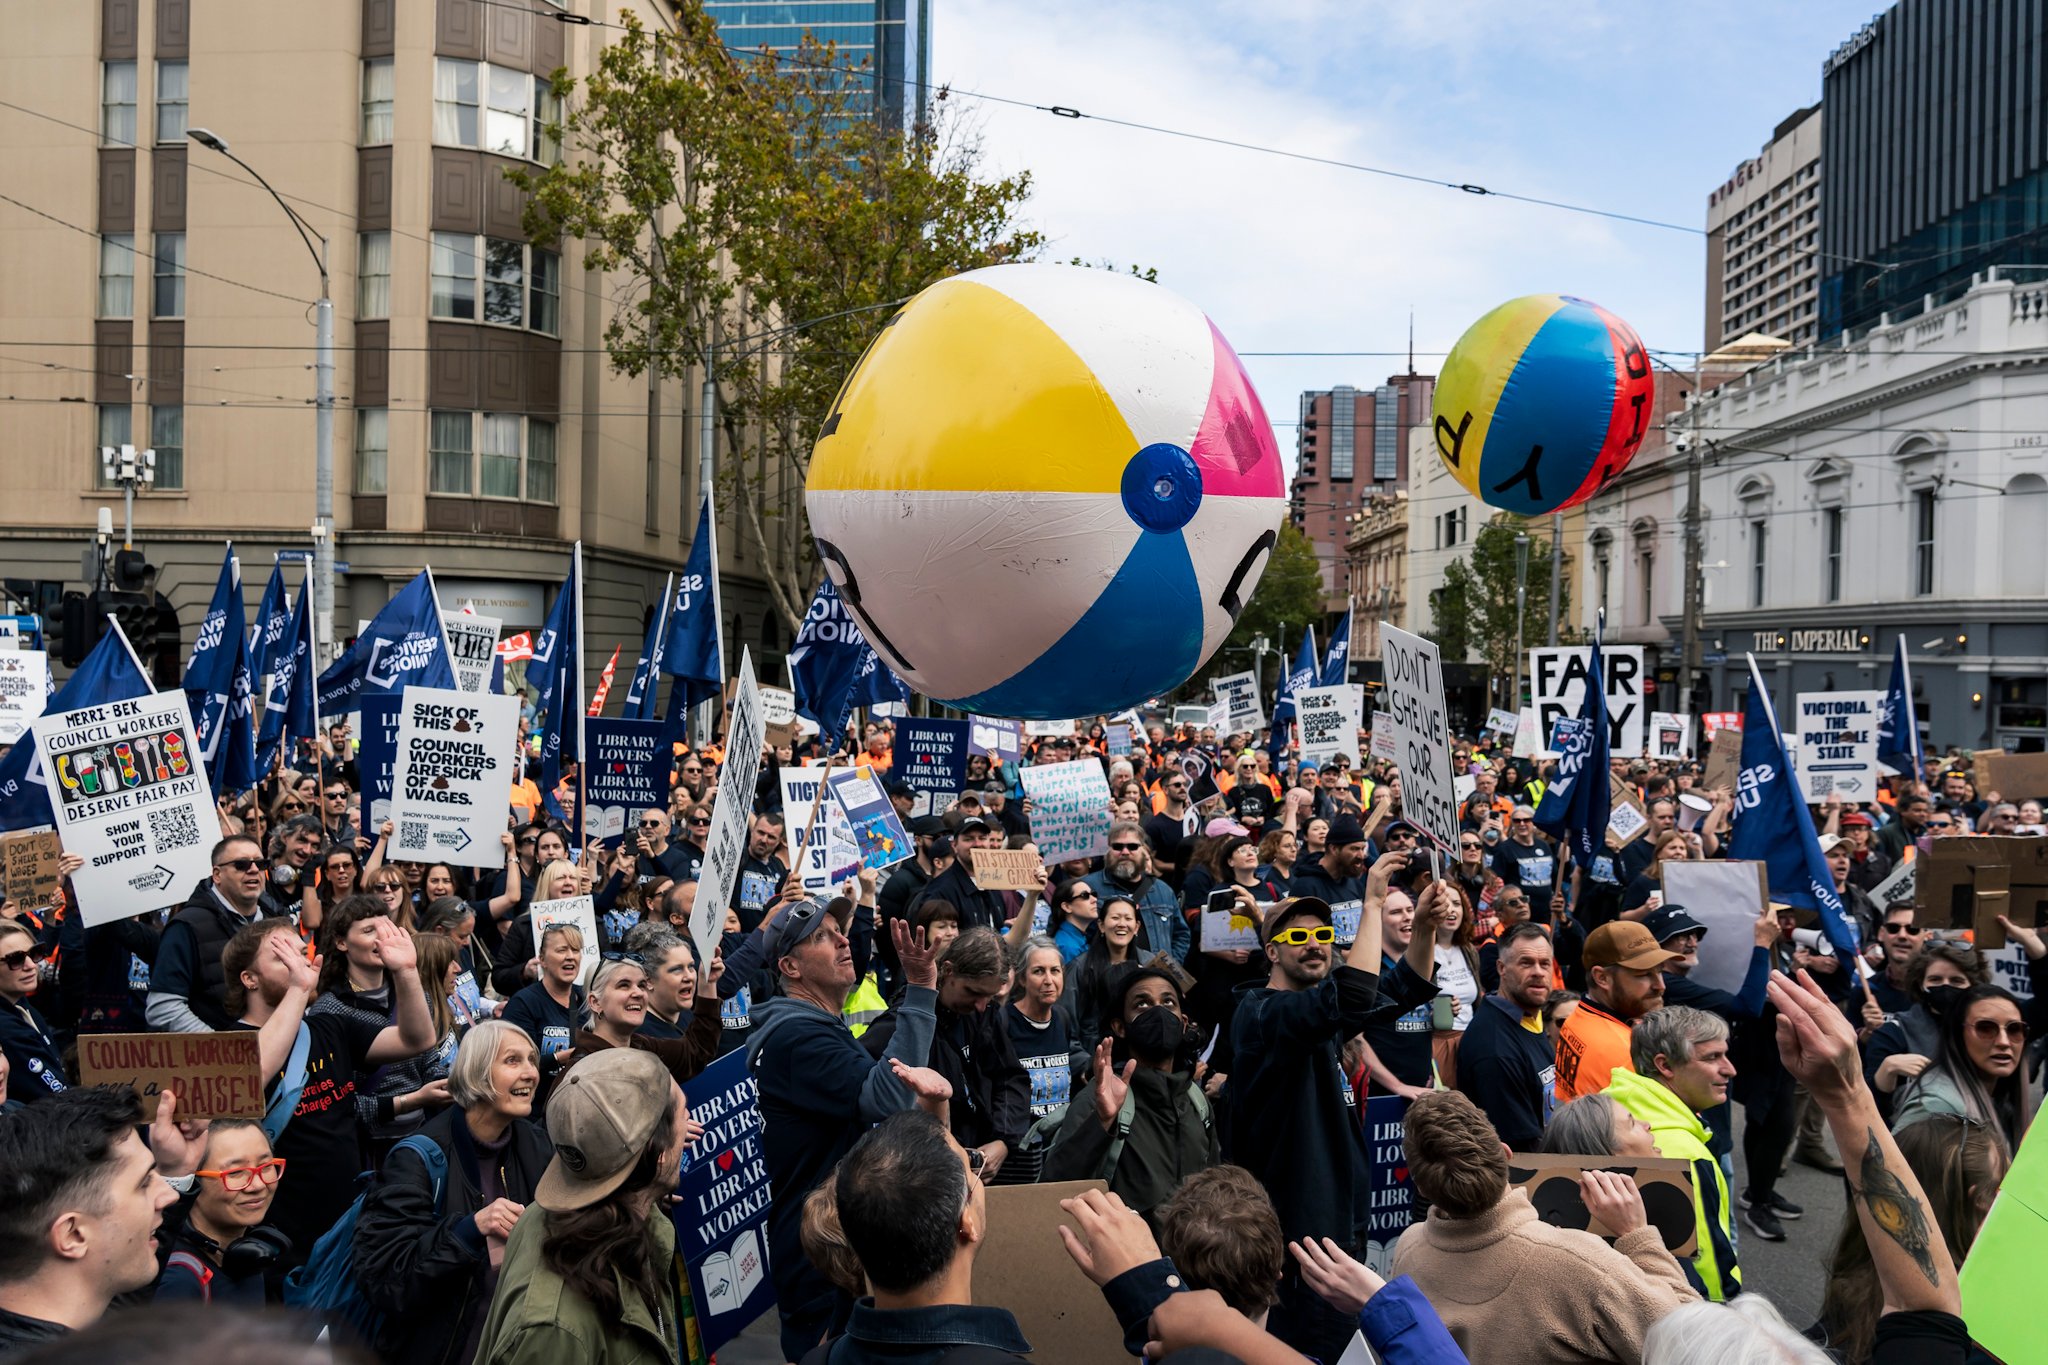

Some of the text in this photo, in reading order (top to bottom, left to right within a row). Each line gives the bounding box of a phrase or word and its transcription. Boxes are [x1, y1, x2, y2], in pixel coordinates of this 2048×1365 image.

[1710, 156, 1763, 208] RYDGES
[465, 625, 495, 635] WORKERS
[1754, 629, 1861, 652] THE IMPERIAL
[476, 661, 489, 670] PAY
[1388, 639, 1431, 694] DON'T
[1216, 676, 1253, 692] VICTORIA.
[1230, 686, 1243, 695] THE
[1230, 701, 1250, 712] STATE
[1301, 694, 1333, 704] SICK OF
[1301, 701, 1321, 710] THIS
[66, 701, 142, 728] MERRI-BEK
[413, 703, 479, 721] SICK OF
[1302, 710, 1340, 721] COUNCIL
[1803, 701, 1871, 715] VICTORIA.
[412, 716, 485, 734] THIS ?
[975, 715, 1014, 729] WORKERS
[1303, 716, 1347, 726] WORKERS
[1392, 689, 1443, 747] SHELVE
[1825, 716, 1848, 730] THE
[50, 712, 181, 750] COUNCIL WORKERS
[1321, 723, 1341, 731] SICK
[1540, 702, 1637, 750] PY
[597, 734, 658, 748] LIBRARY
[908, 730, 956, 742] LIBRARY
[1304, 730, 1316, 739] OF
[1305, 736, 1339, 745] WAGES.
[410, 737, 486, 756] COUNCIL
[910, 742, 953, 753] LOVERS
[1817, 746, 1855, 760] STATE
[408, 750, 497, 770] WORKERS
[599, 748, 653, 762] LOVERS
[906, 764, 953, 776] LIBRARY
[1408, 740, 1437, 786] OUR
[407, 763, 483, 781] ARE SICK
[406, 775, 429, 788] OF
[593, 775, 654, 789] LIBRARY
[902, 776, 956, 789] WORKERS
[1027, 777, 1064, 795] failure
[68, 779, 196, 821] DESERVE FAIR PAY
[405, 788, 473, 806] WAGES.
[588, 788, 657, 803] WORKERS
[1042, 804, 1059, 815] NO
[1061, 799, 1079, 814] PAY
[1082, 797, 1108, 808] offer
[1401, 769, 1457, 852] WAGES!
[402, 811, 470, 823] SHOW YOUR SUPPORT
[1031, 818, 1043, 828] on
[1046, 815, 1063, 826] the
[105, 820, 140, 837] SHOW
[112, 832, 144, 849] YOUR
[432, 832, 463, 841] SERVICES
[436, 838, 458, 846] UNION
[1038, 835, 1094, 856] crisis!
[92, 845, 147, 868] SUPPORT
[991, 852, 1040, 868] STRIKING
[128, 871, 165, 886] SERVICES
[134, 879, 161, 891] UNION
[1882, 874, 1910, 900] SICK
[539, 899, 585, 914] SUPPORT
[742, 901, 764, 911] DESERV
[2010, 977, 2033, 994] STA
[88, 1037, 261, 1070] COUNCIL WORKERS
[1044, 1053, 1070, 1067] WORKER
[144, 1075, 263, 1116] a RAISE!!
[294, 1096, 332, 1117] Change
[692, 1104, 761, 1162] LOVERS
[698, 1157, 767, 1217] LIBRAR
[1371, 1187, 1410, 1209] LIBR
[698, 1180, 773, 1245] WORKE
